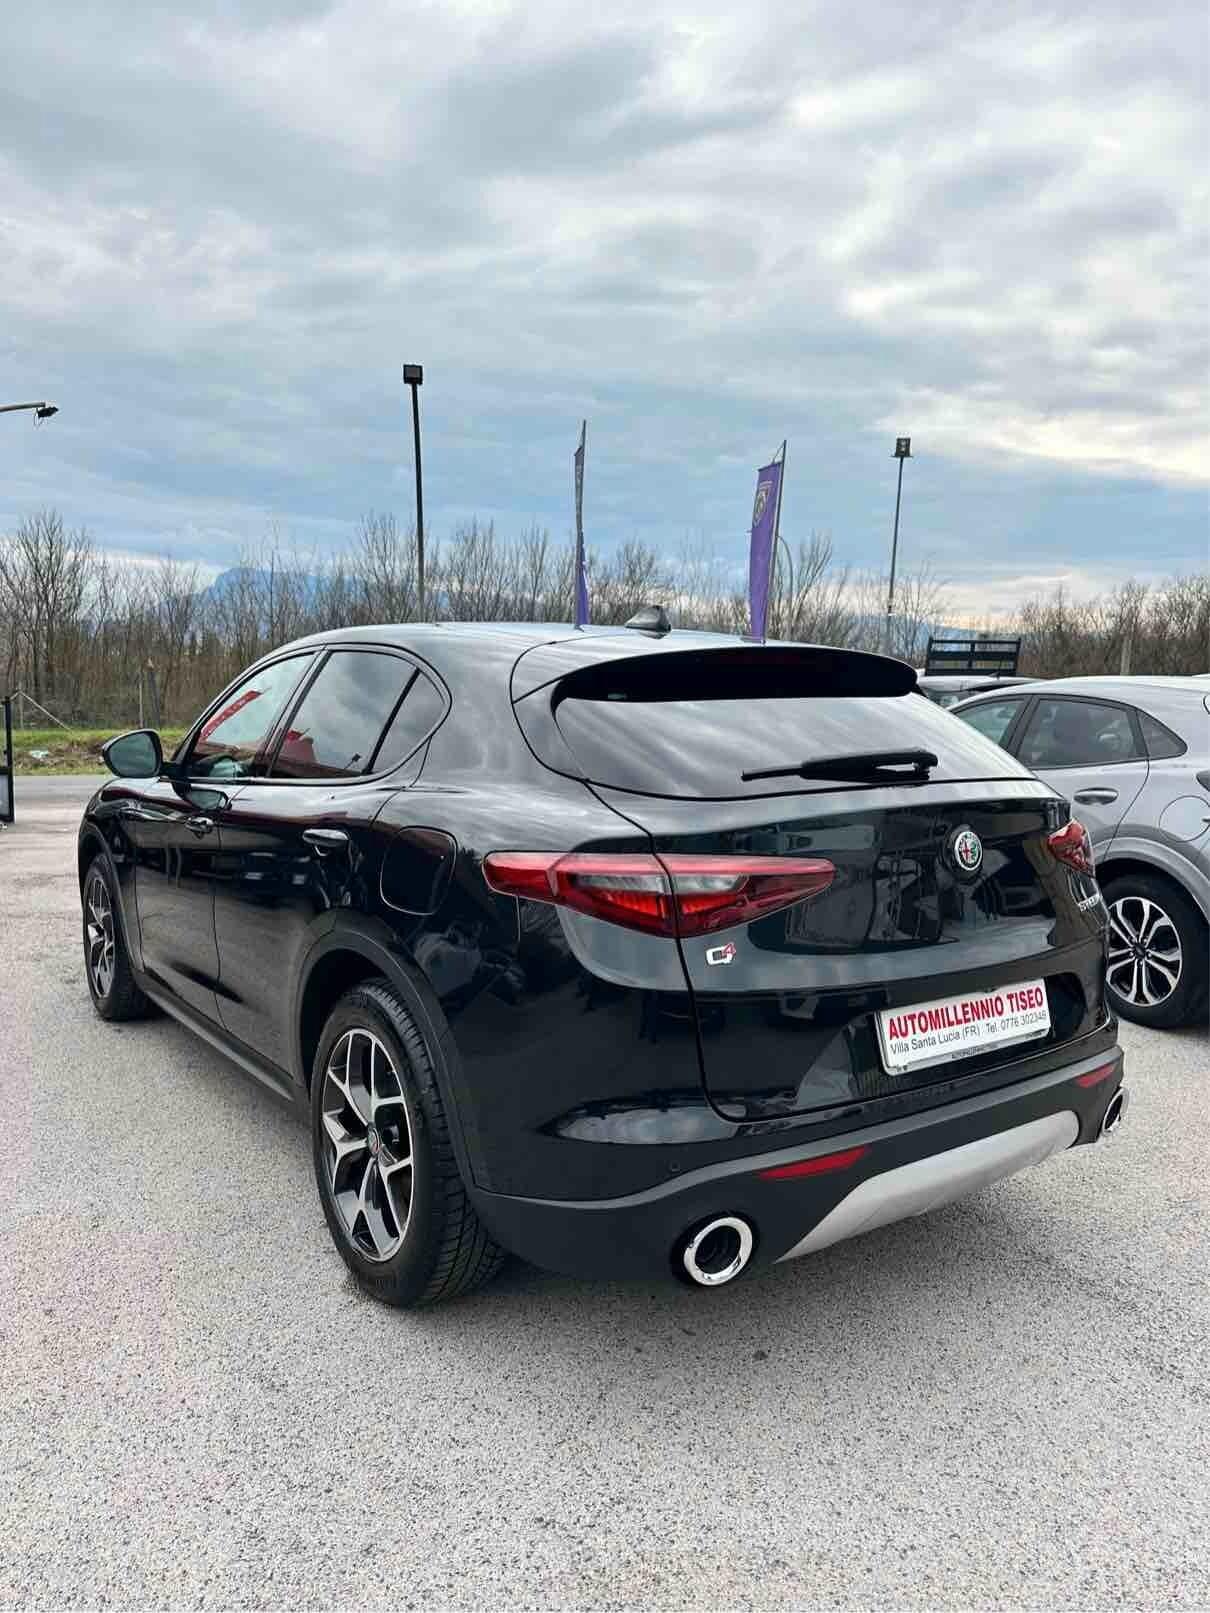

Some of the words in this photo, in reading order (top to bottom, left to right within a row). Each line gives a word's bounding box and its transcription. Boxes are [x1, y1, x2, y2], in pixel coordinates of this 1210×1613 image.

[889, 995, 1004, 1040] AUTOMILLENNIO
[1006, 986, 1043, 1013] TISEO
[890, 1040, 910, 1055] Villa
[911, 1034, 937, 1050] Santa
[937, 1029, 961, 1045] Lucia
[1000, 1015, 1020, 1031] 0776
